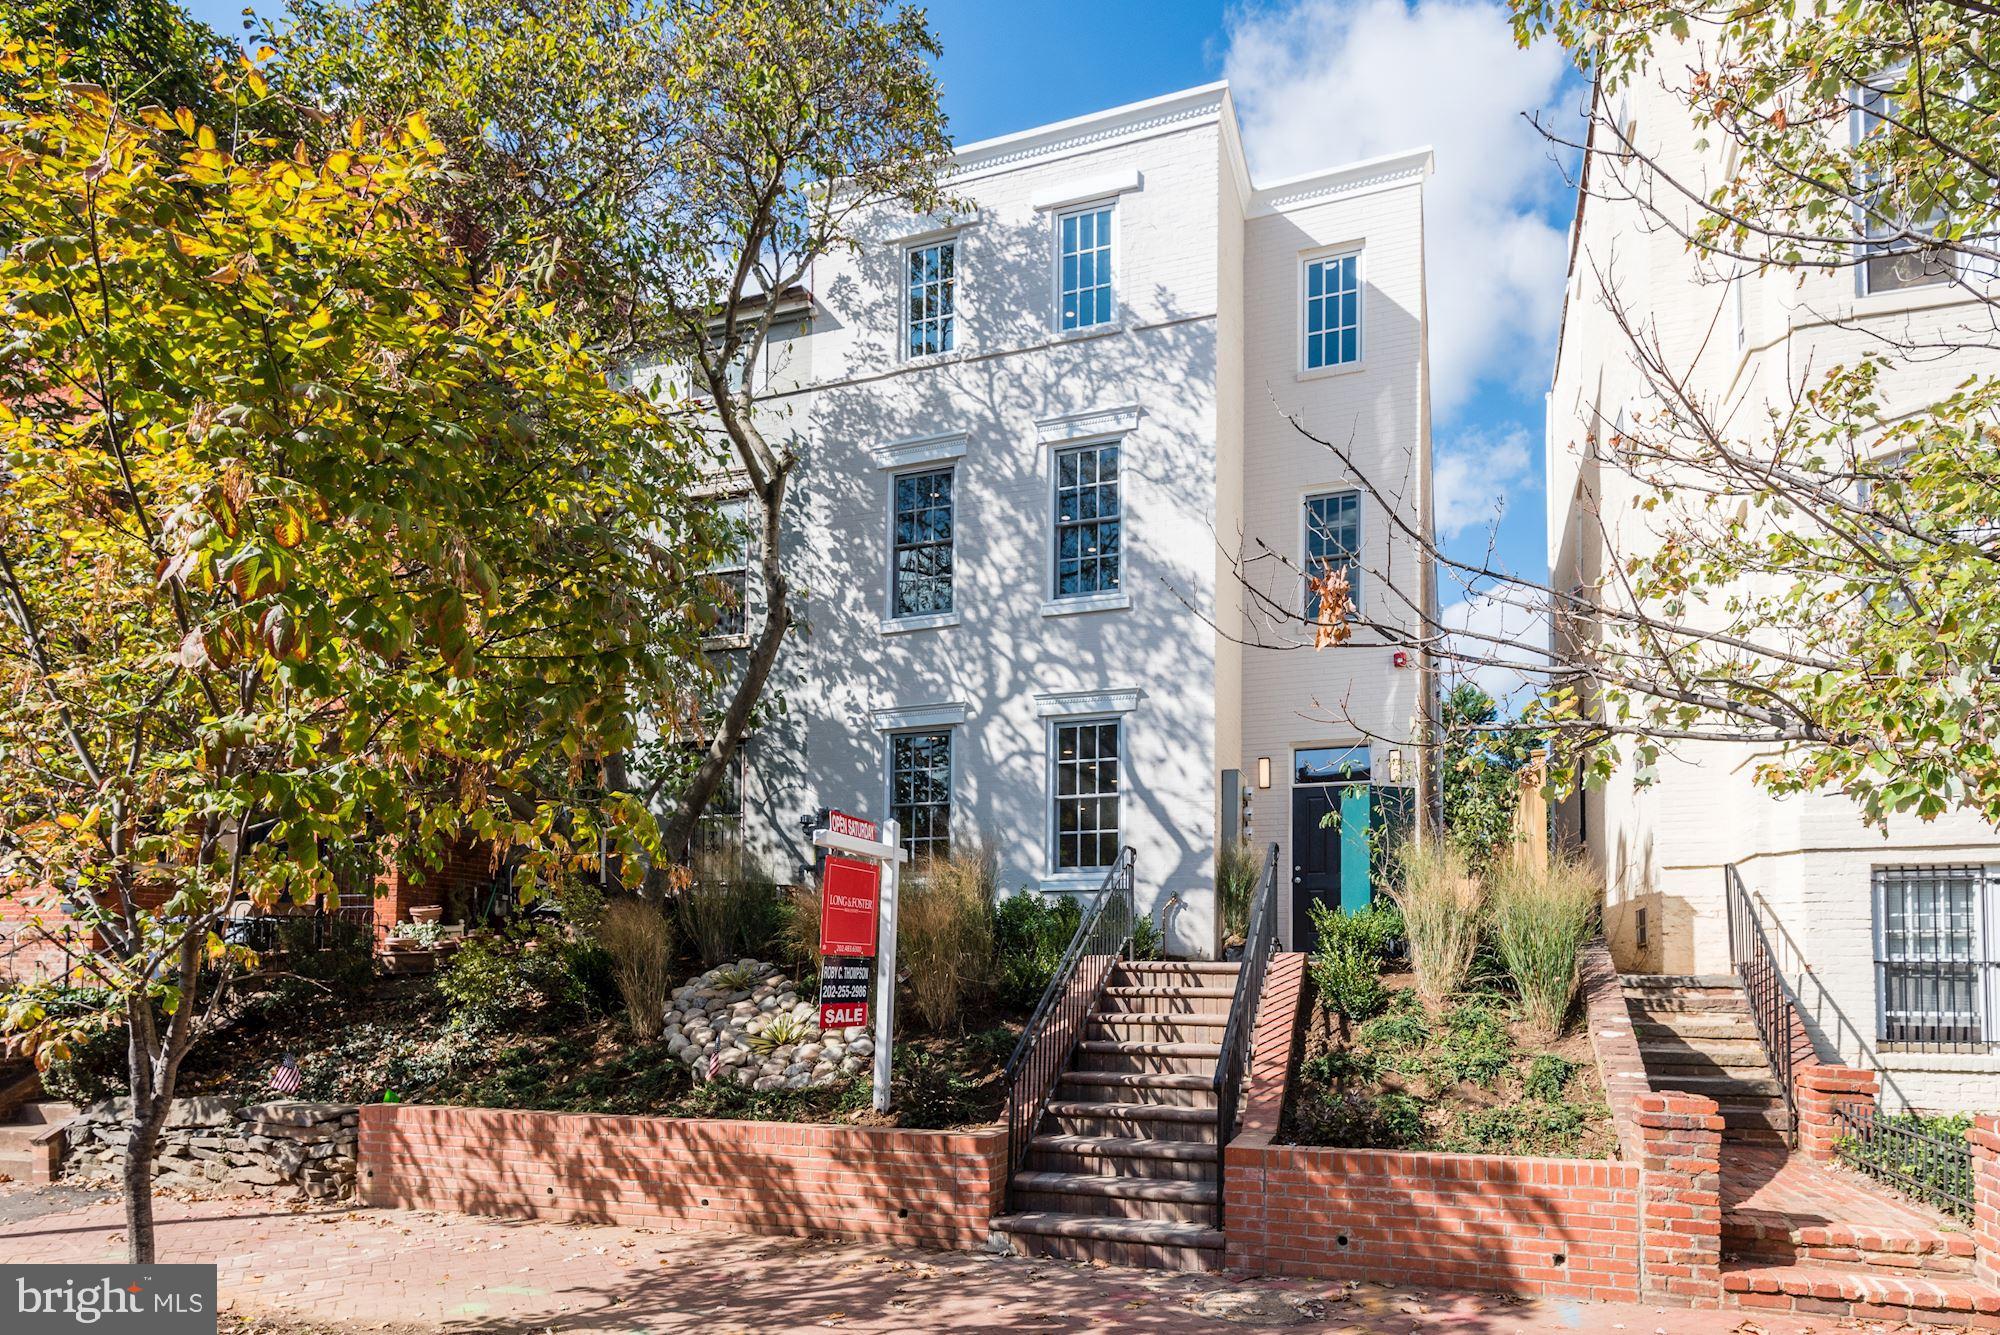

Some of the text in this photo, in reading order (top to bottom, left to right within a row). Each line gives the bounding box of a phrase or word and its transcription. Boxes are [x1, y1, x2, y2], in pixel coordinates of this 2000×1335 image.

[832, 815, 874, 840] OPEN SATURDAY
[823, 966, 838, 979] ROBY
[844, 966, 869, 980] THOMPSON
[822, 984, 867, 998] 202-255-2986
[825, 1008, 863, 1024] SALE
